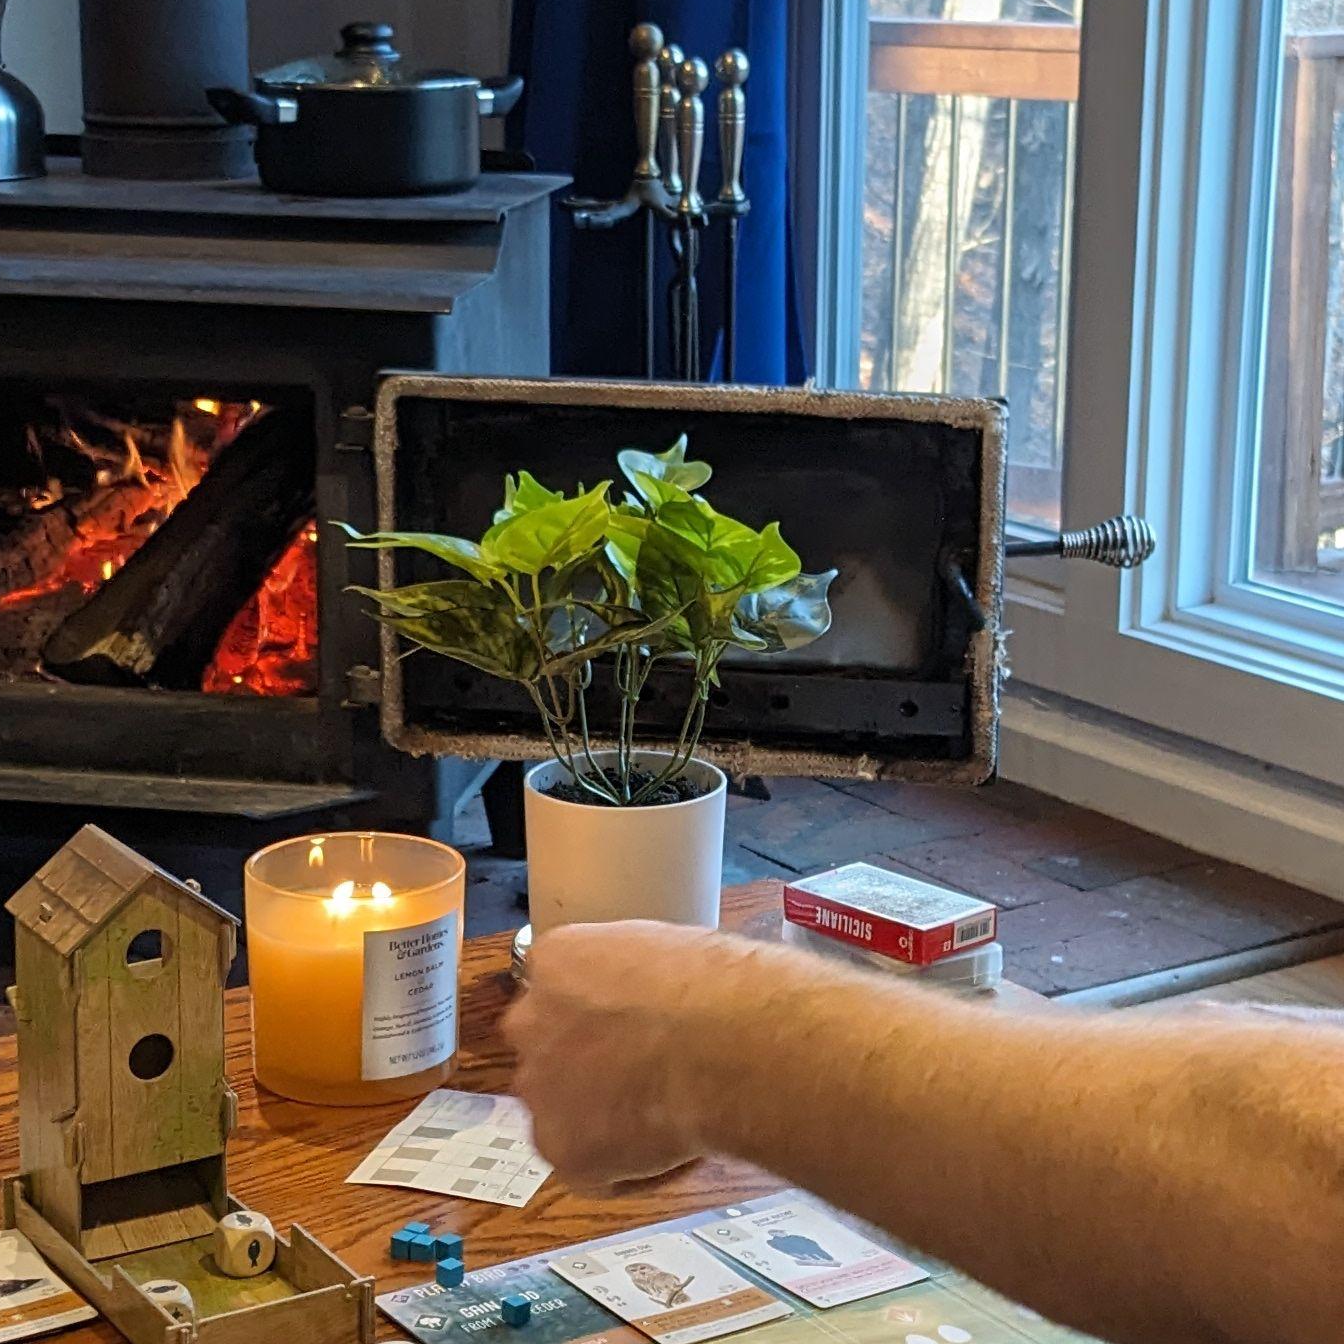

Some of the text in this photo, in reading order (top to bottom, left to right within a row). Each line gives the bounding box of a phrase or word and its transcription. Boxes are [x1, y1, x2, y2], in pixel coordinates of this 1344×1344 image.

[815, 905, 873, 941] SICILIANE
[394, 968, 424, 981] LEMON
[415, 1283, 453, 1299] PLA
[470, 1268, 506, 1285] BIRD
[459, 1302, 502, 1319] GAIN
[460, 1317, 498, 1333] FROM
